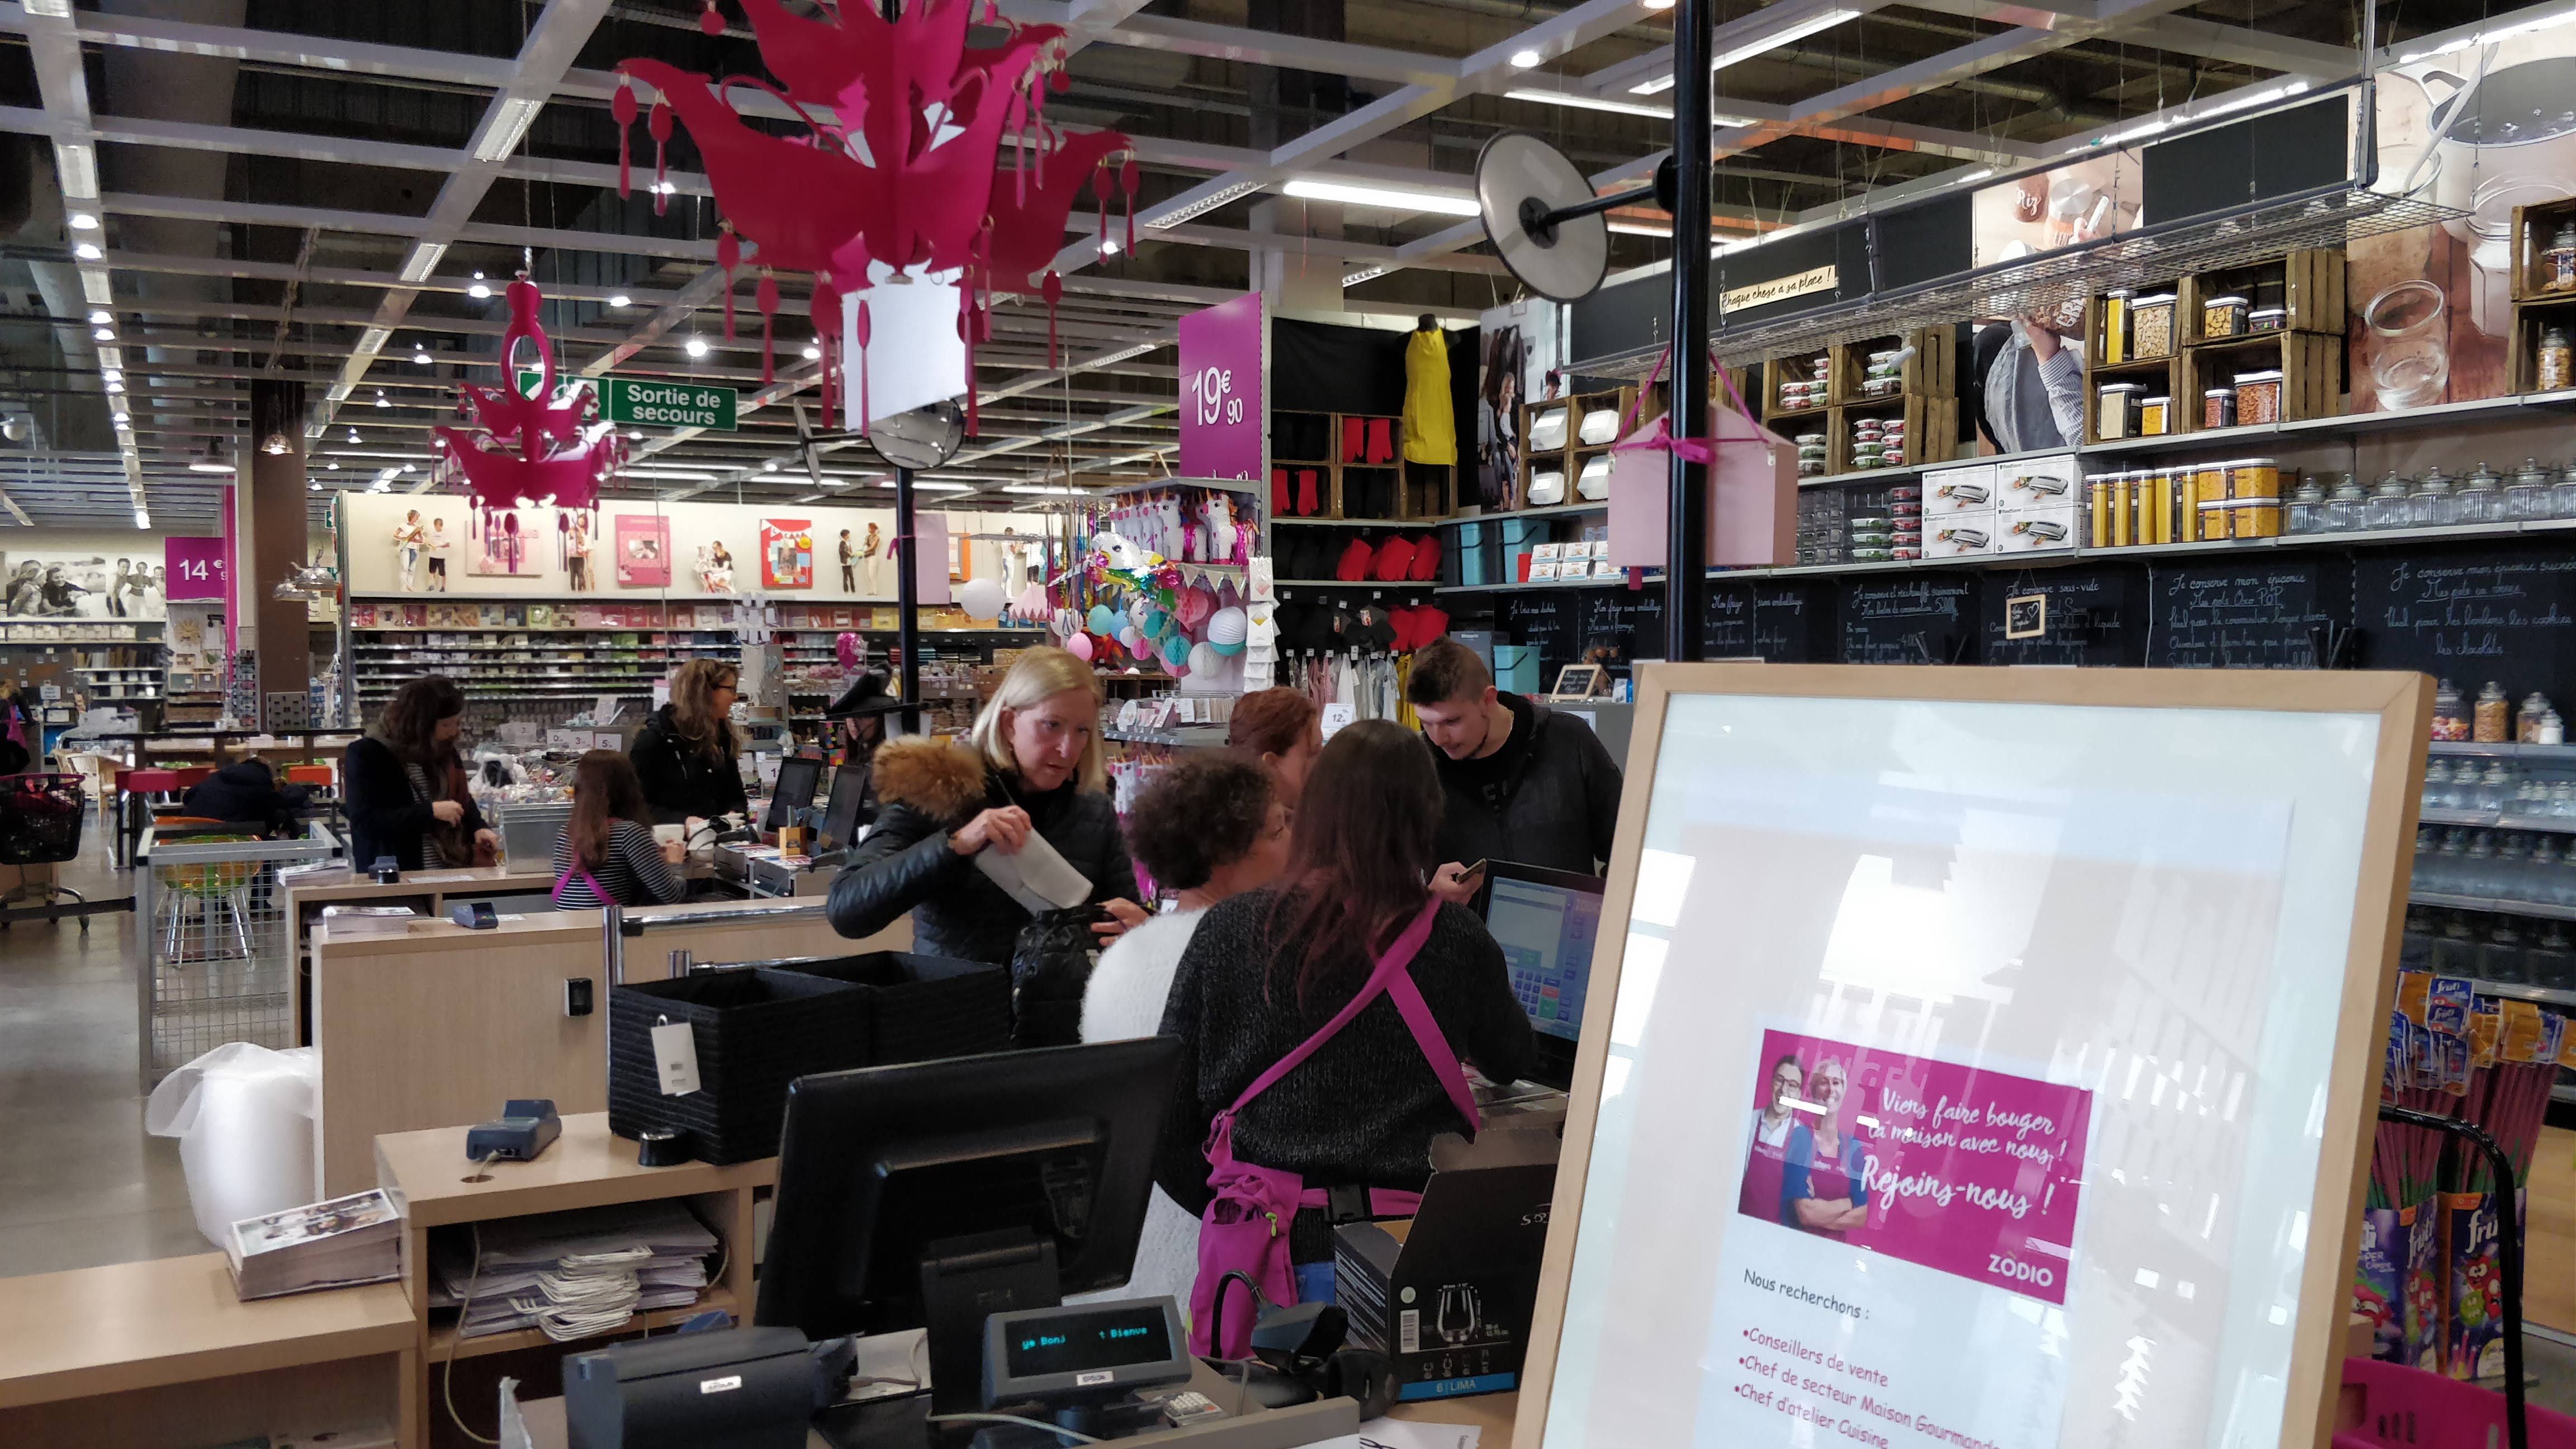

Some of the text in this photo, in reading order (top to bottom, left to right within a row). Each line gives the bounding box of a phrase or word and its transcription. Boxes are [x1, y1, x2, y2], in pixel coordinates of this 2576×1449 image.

[1753, 285, 1776, 299] chose
[1798, 274, 1823, 292] place
[627, 384, 721, 409] Sortie de
[632, 406, 716, 425] secours
[2059, 577, 2100, 593] sous-vide
[2169, 573, 2186, 596] Je
[2190, 577, 2228, 589] conserve
[2234, 576, 2259, 586] mon
[1932, 1095, 1981, 1129] faire
[1985, 1101, 2056, 1141] bouger
[1890, 1125, 1957, 1149] maison
[1959, 1136, 2001, 1154] avec
[2005, 1140, 2050, 1166] nous
[1860, 1154, 2056, 1220] Rejoins-nous !
[2464, 1209, 2499, 1254] fru
[1744, 1268, 1776, 1291] Nous
[1779, 1282, 1862, 1319] recherchons
[1749, 1328, 1888, 1388] Conseillers de vente
[1450, 1379, 1476, 1392] LIMA
[1744, 1356, 1778, 1379] Chef
[1782, 1368, 1798, 1386] de
[1801, 1378, 1857, 1407] secteur
[1859, 1395, 1911, 1428] Maison
[1740, 1384, 1889, 1449] Chef d'atelier Cuisine
